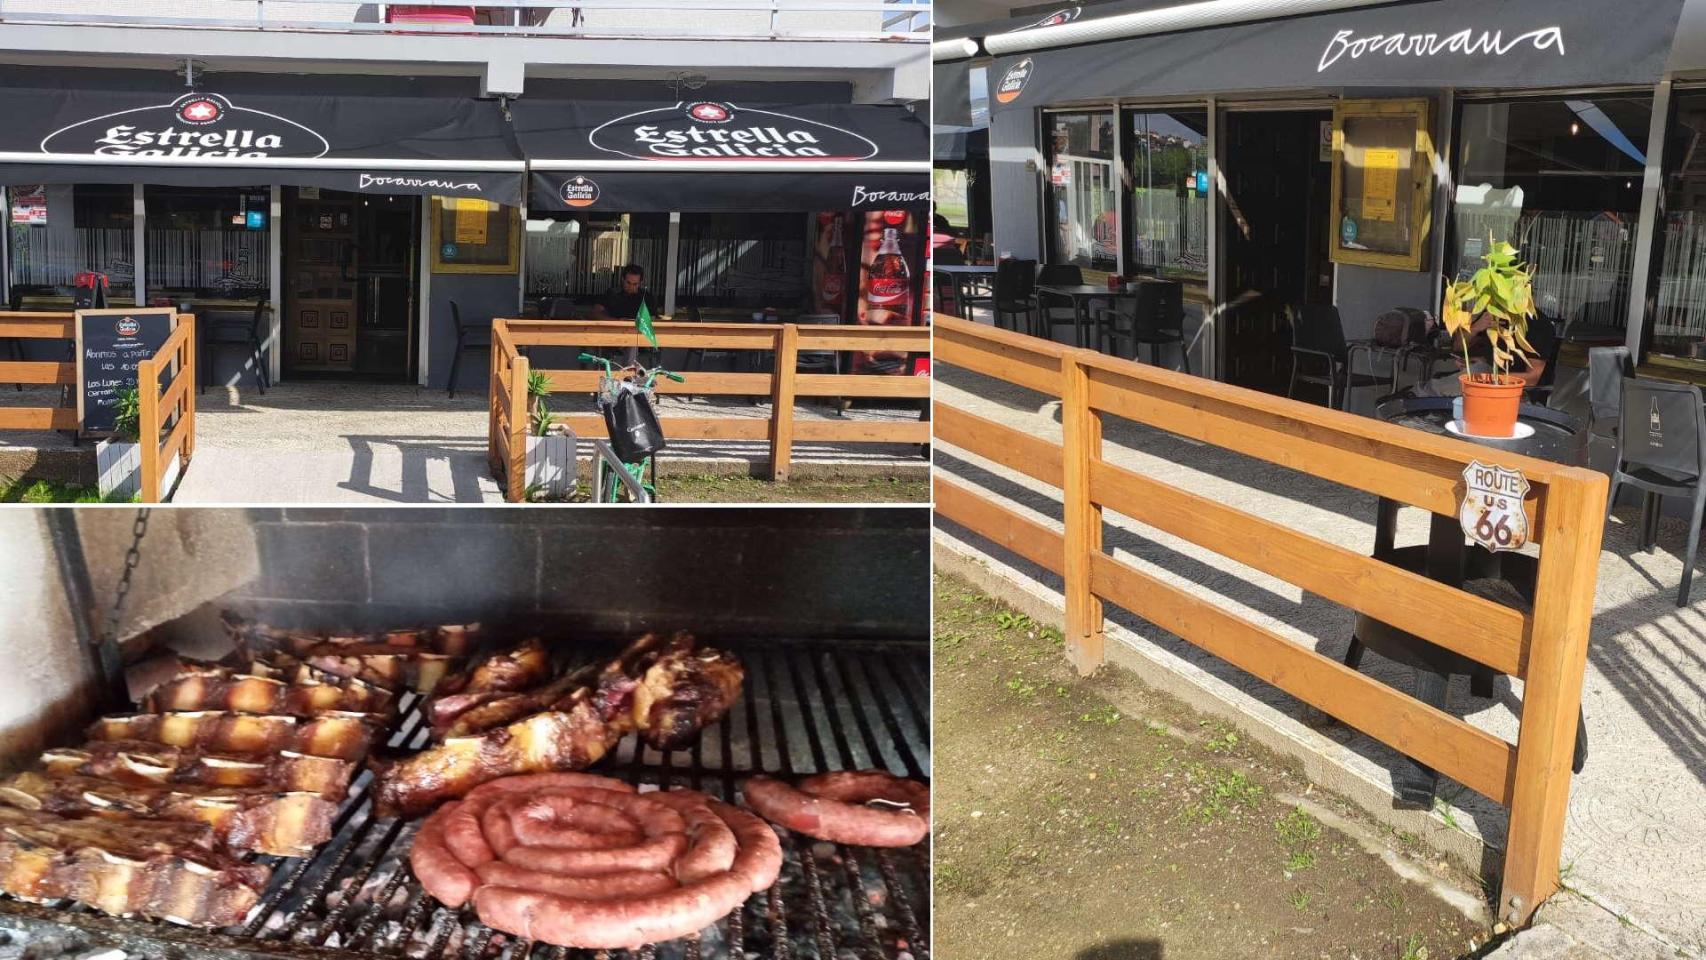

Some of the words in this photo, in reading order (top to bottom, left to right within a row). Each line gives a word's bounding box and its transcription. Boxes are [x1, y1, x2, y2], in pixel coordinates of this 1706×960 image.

[95, 125, 283, 148] Estrella
[634, 125, 820, 143] Estrella
[649, 143, 830, 157] Galicia
[567, 184, 593, 192] Estrella
[567, 191, 592, 199] Galicia
[1475, 469, 1519, 493] ROUTE
[1484, 495, 1507, 510] US
[1477, 510, 1512, 545] 66
